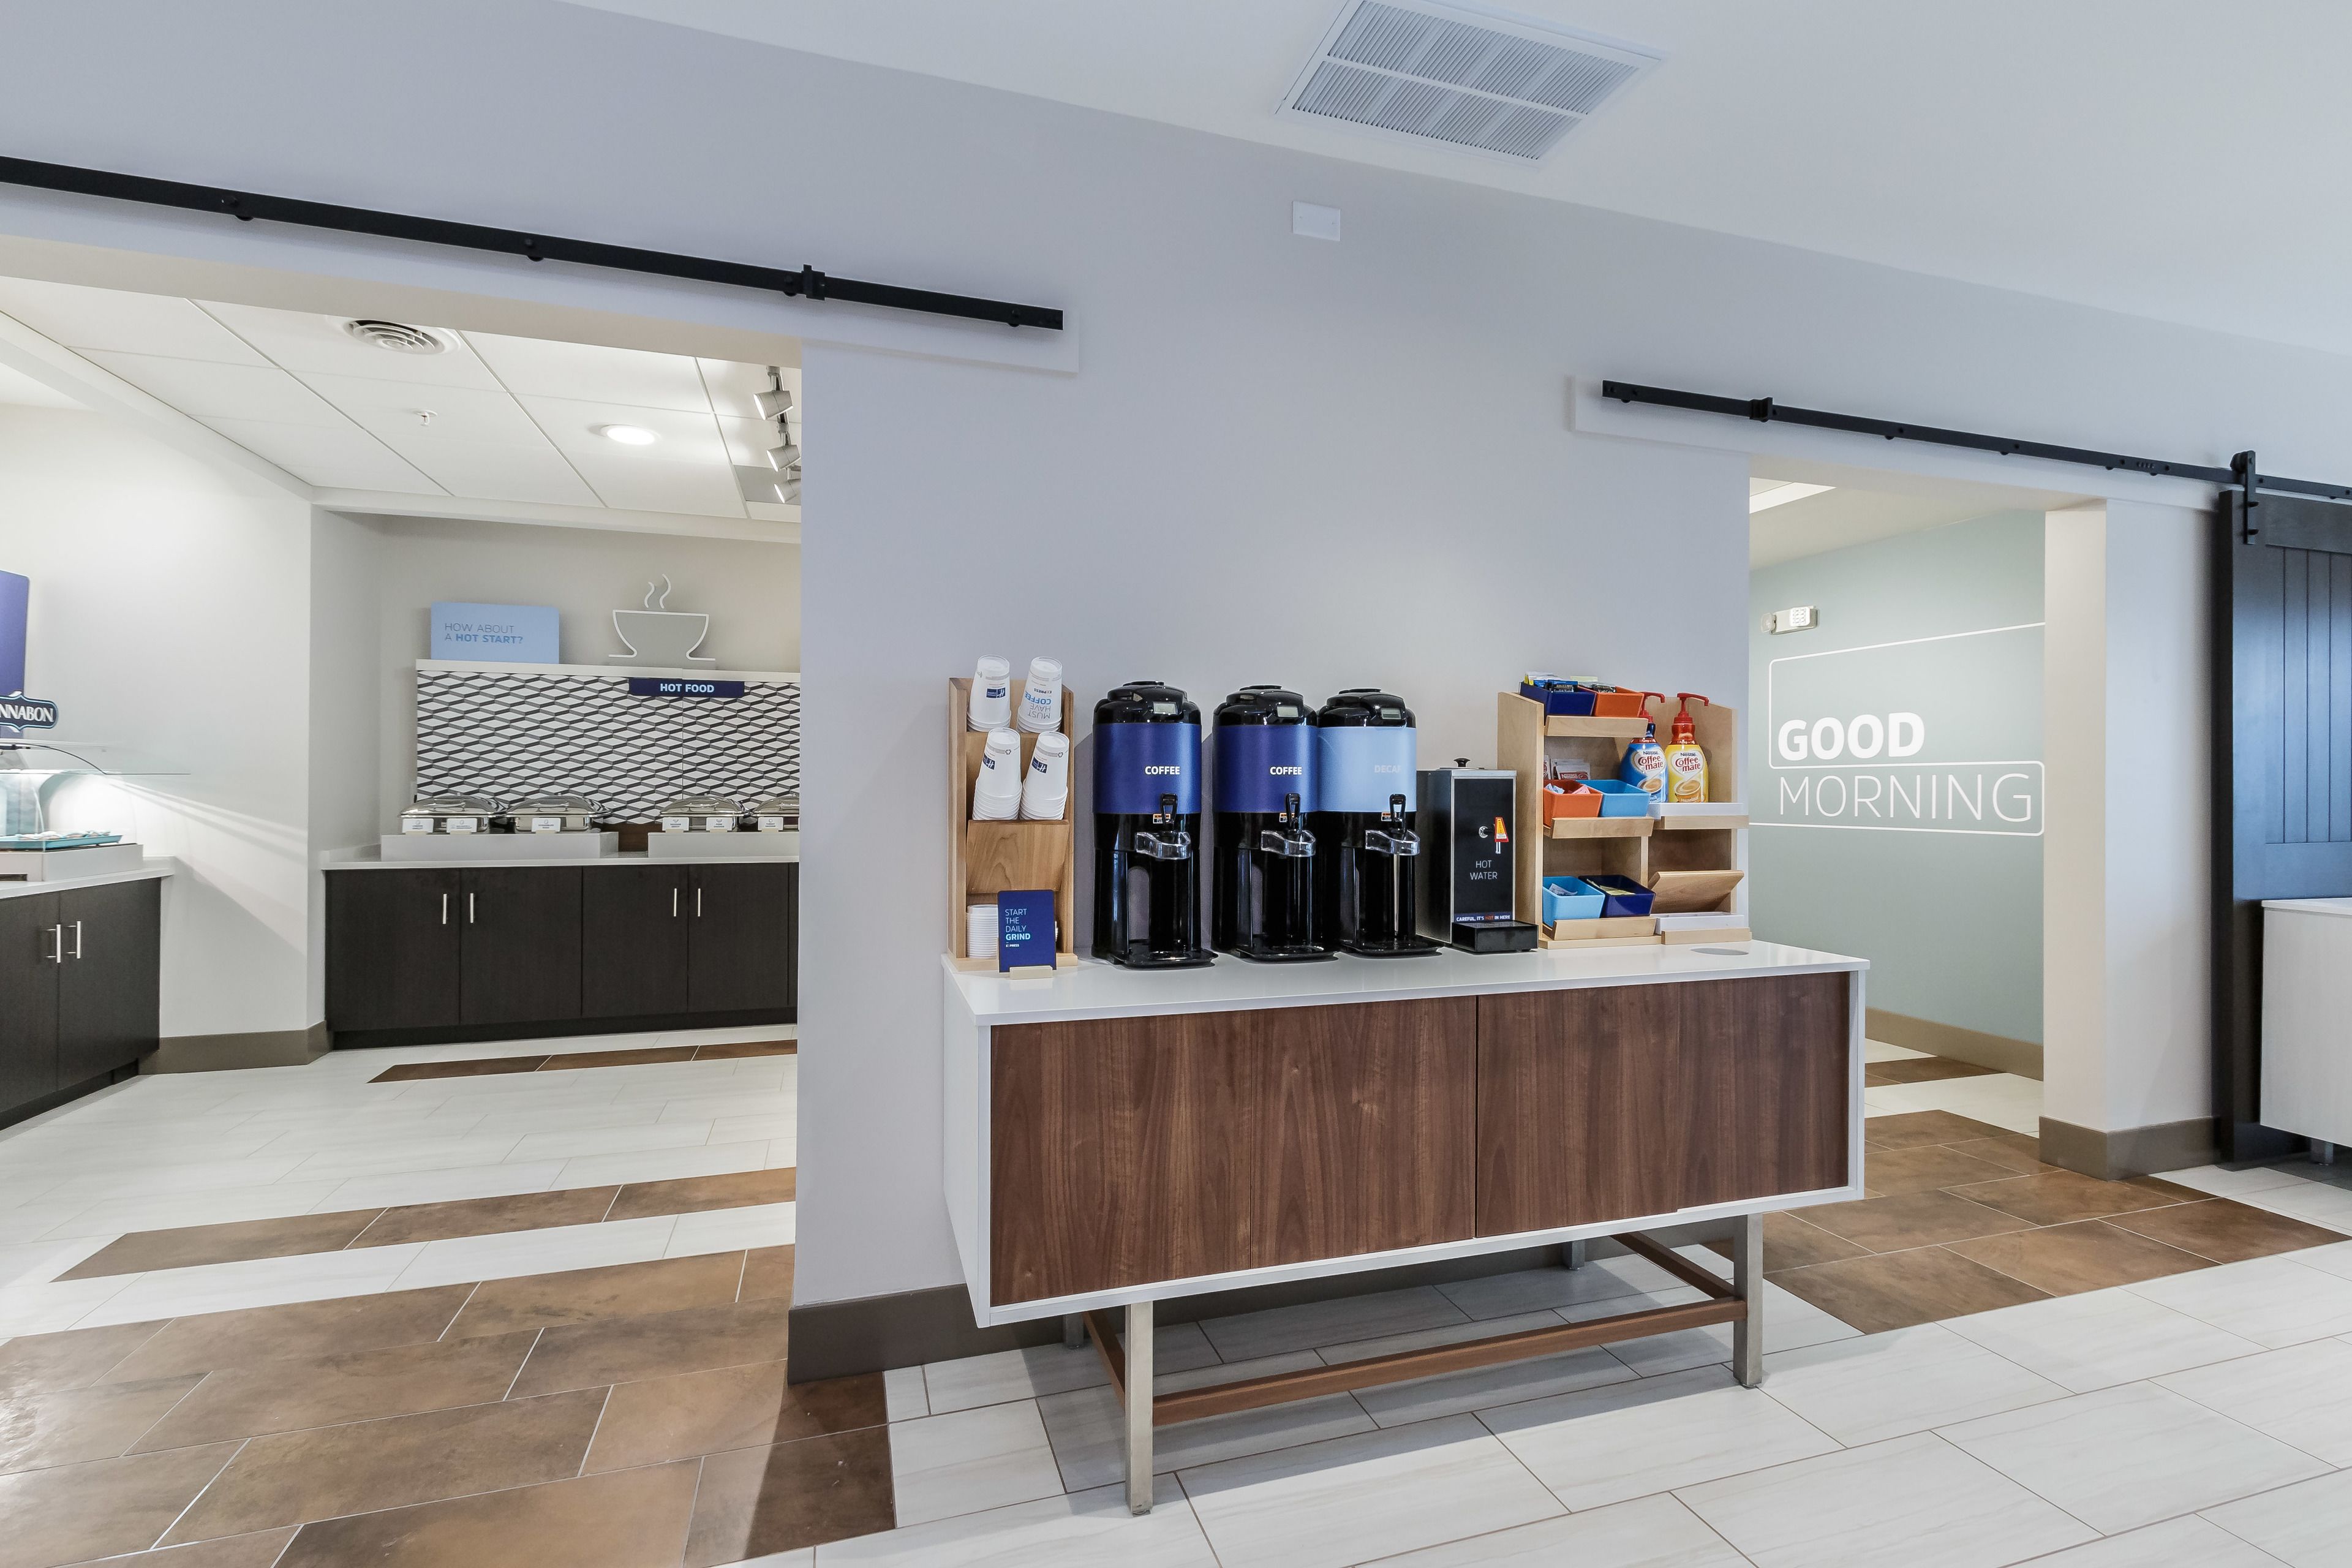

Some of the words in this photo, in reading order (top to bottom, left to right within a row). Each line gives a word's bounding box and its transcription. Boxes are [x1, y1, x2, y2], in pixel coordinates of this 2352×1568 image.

[445, 622, 473, 631] HOW
[477, 624, 514, 633] ABOUT
[455, 633, 478, 642] HOT
[482, 635, 523, 644] START?
[660, 683, 682, 692] HOT
[685, 684, 715, 693] FOOD
[1025, 690, 1052, 705] COFFEE
[1030, 702, 1051, 713] HAVE
[1028, 709, 1050, 719] MUST
[1778, 712, 1925, 761] GOOD
[1145, 766, 1180, 775] COFFEE
[1270, 766, 1302, 775] COFFEE
[1780, 773, 2032, 823] MORNING
[1476, 860, 1492, 869] HOT
[1469, 872, 1498, 880] WATER
